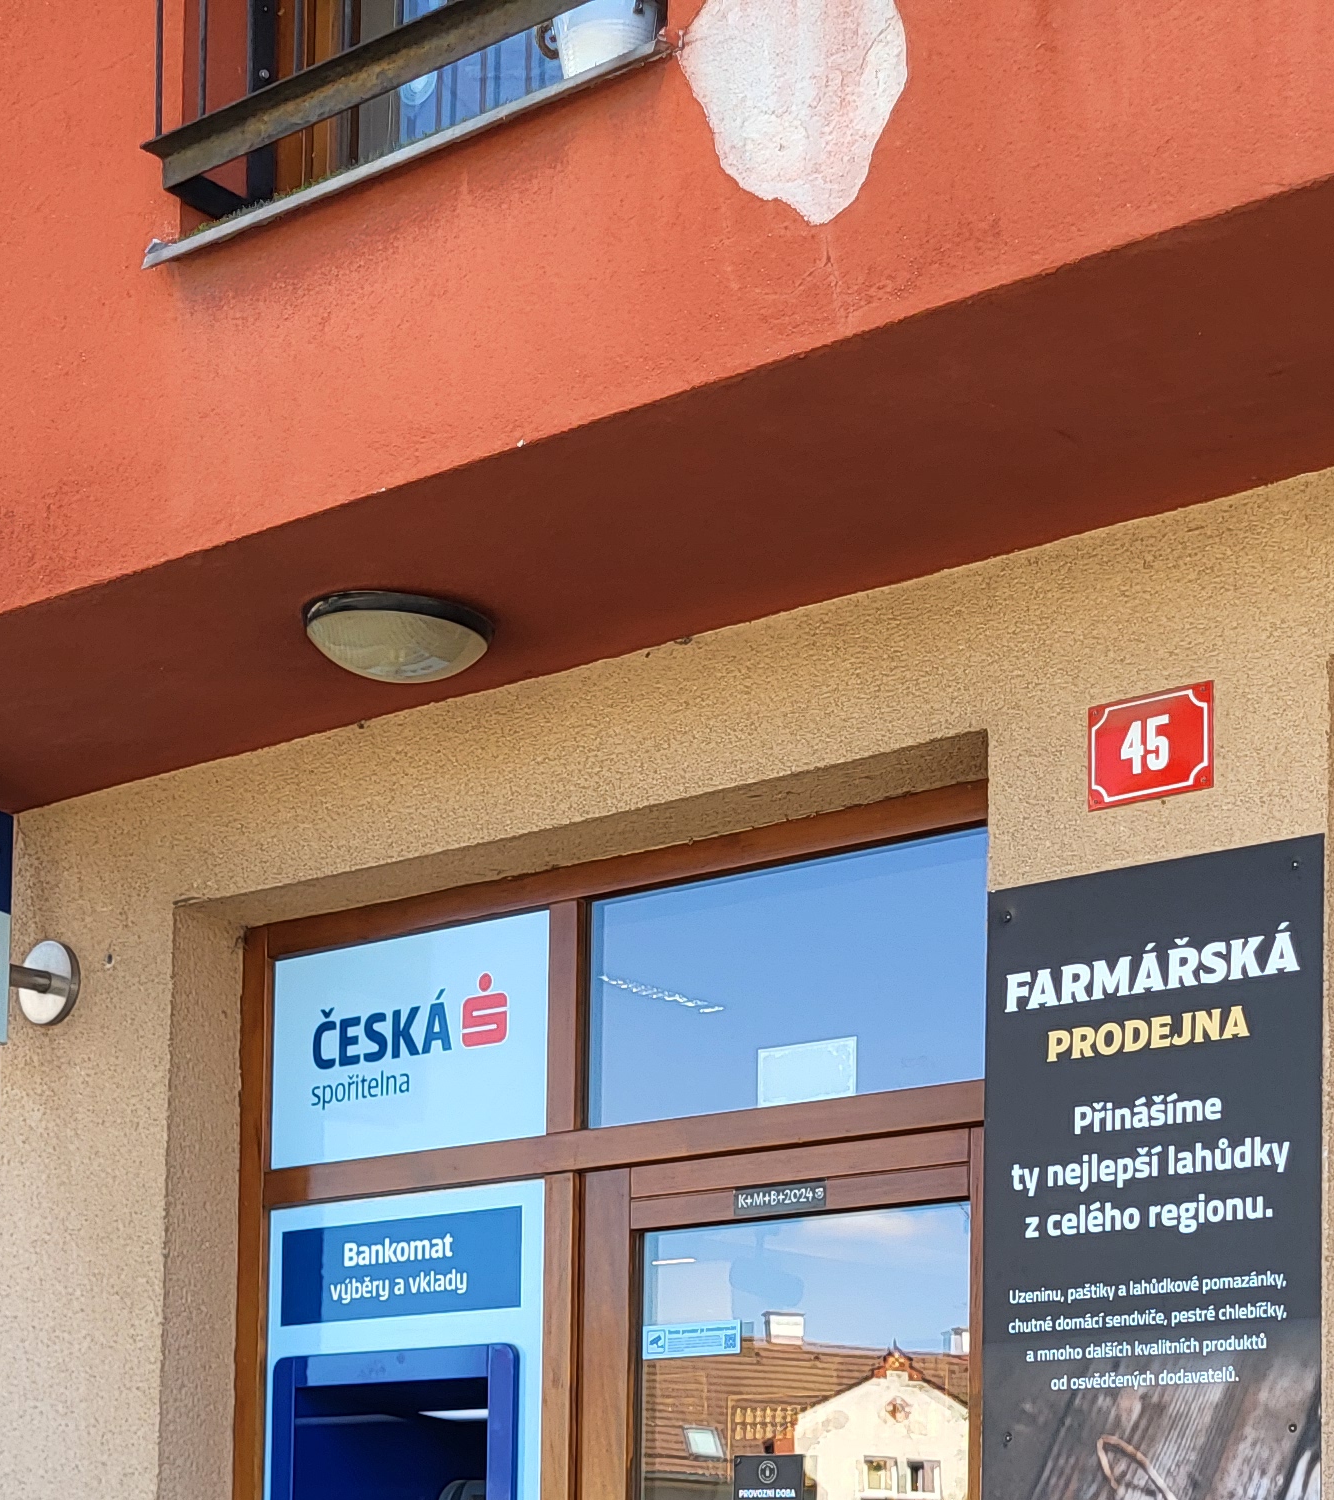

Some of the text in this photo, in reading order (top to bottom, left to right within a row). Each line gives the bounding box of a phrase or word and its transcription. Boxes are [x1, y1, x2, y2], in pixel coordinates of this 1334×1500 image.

[1120, 714, 1170, 775] 45
[1004, 921, 1301, 1013] FARMÁŘSKÁ
[312, 988, 453, 1070] ČESKÁ
[1046, 1005, 1251, 1062] PRODEJNA
[311, 1070, 411, 1111] spořitelna
[1074, 1093, 1223, 1135] Přinášíme
[1011, 1136, 1291, 1197] ty nejlepší lahůdky
[738, 1187, 813, 1208] K+M+B+2024
[1024, 1193, 1273, 1238] z celého regionu.
[343, 1233, 454, 1267] Bankomat
[330, 1268, 468, 1304] výběry a vklady
[1009, 1271, 1287, 1304] Uzeninu, paštiky a lahůdkové pomazánky,
[1008, 1301, 1287, 1334] chutné domácí sendviče, pestré chlebíčky,
[1026, 1332, 1267, 1362] a mnoho dalších kvalitních produktů
[1050, 1366, 1239, 1391] od osvědčených dodavatelů.
[738, 1488, 796, 1498] PROVOZNÍ DOBA
